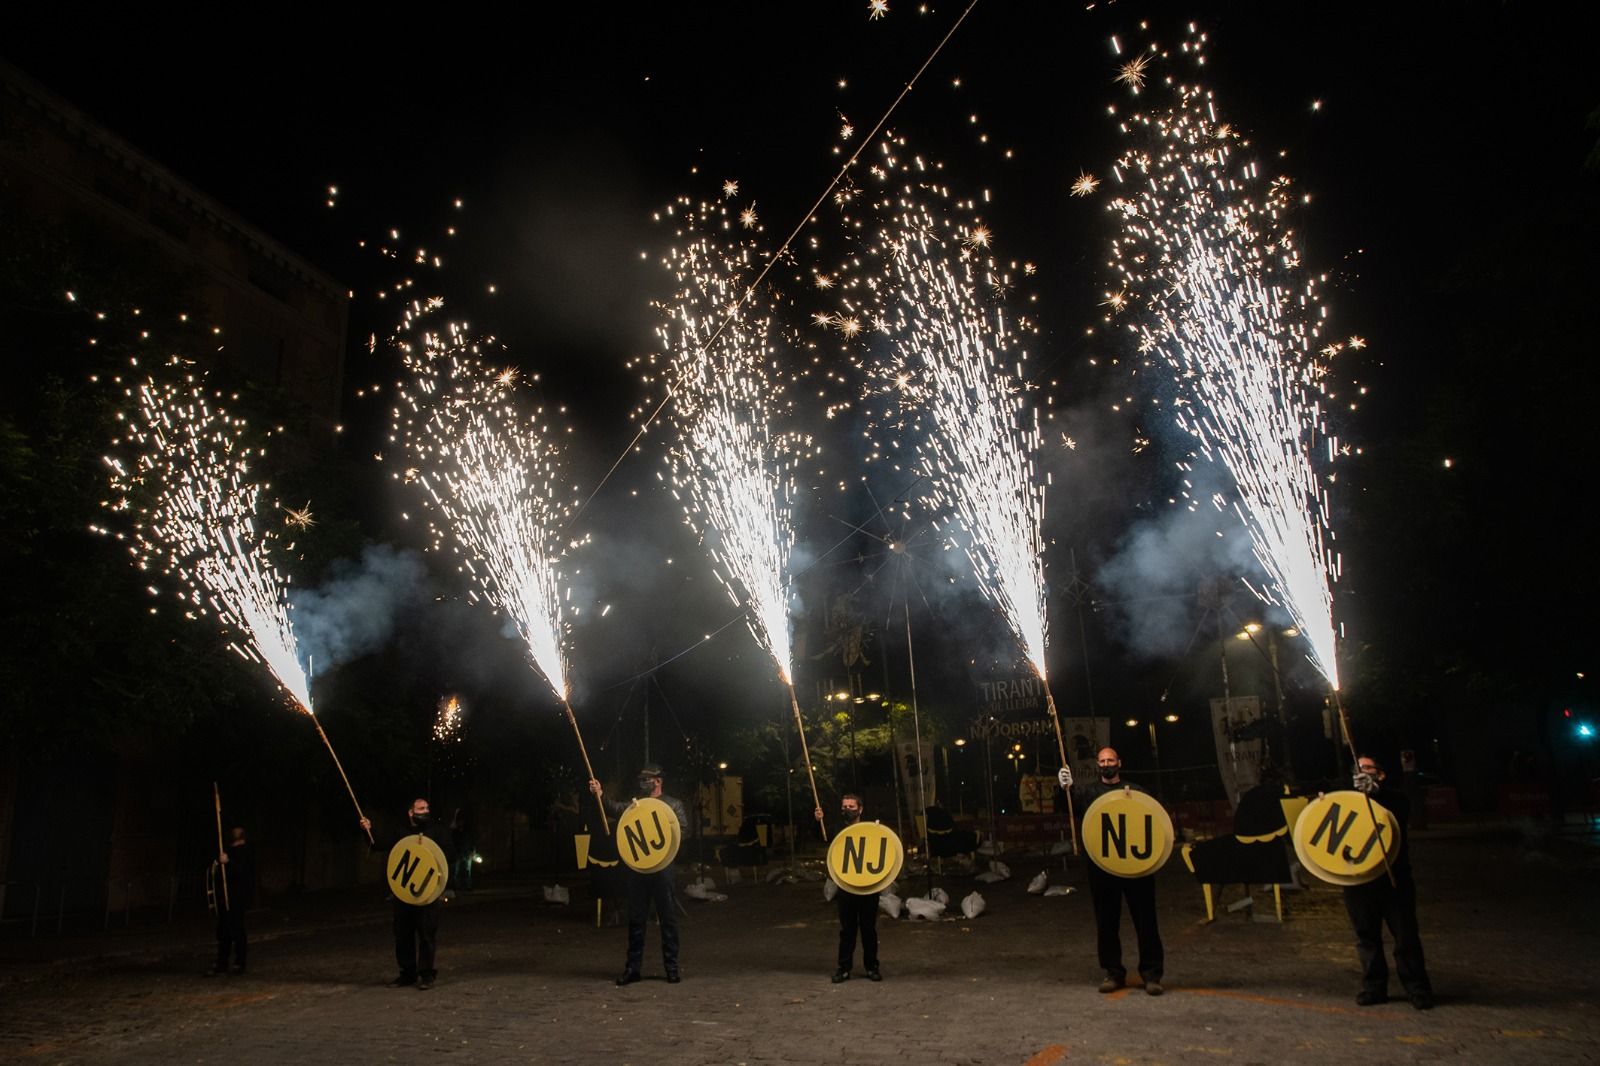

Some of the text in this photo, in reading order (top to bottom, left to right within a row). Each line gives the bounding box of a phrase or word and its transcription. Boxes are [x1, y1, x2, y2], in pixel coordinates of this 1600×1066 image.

[624, 810, 666, 863] NJ
[842, 836, 888, 875] NJ
[1101, 813, 1152, 860] NJ
[1309, 802, 1386, 865] NJ
[391, 849, 435, 898] NJ
